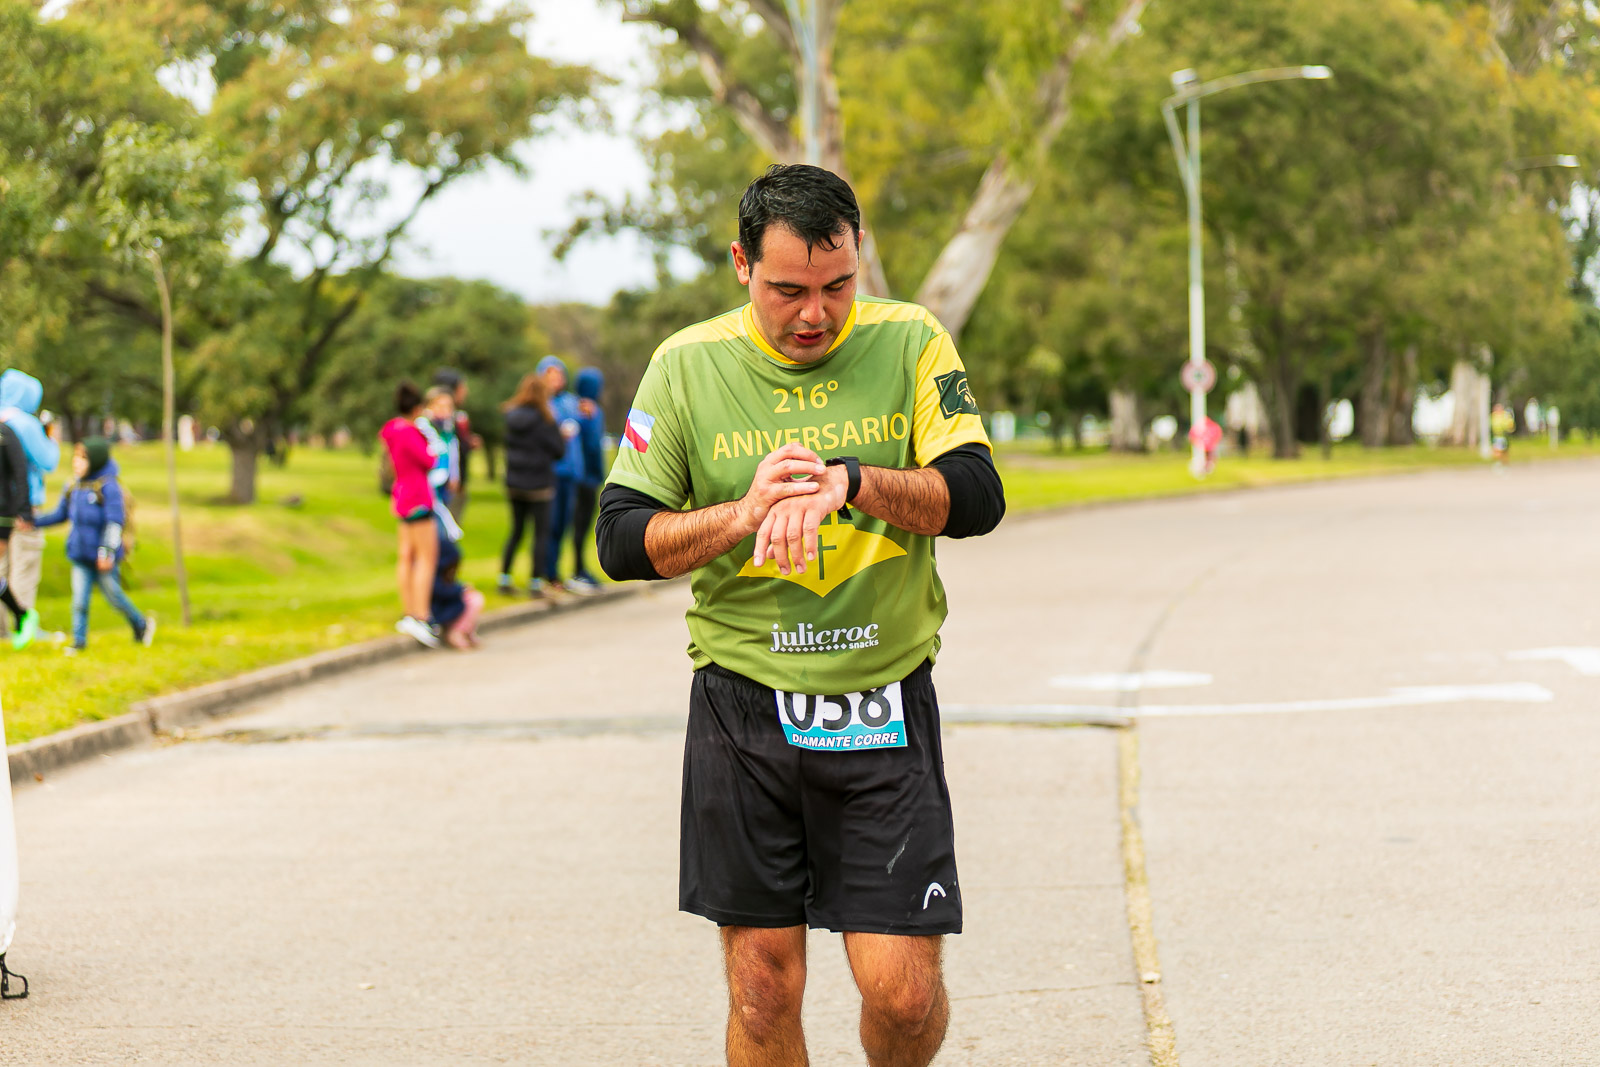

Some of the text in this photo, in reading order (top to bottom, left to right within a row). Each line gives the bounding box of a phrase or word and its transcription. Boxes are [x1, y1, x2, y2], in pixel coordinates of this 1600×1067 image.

[772, 380, 839, 414] 216°
[713, 412, 908, 461] ANIVERSARIO
[769, 622, 879, 653] julicroc
[848, 639, 879, 650] snacks
[783, 684, 892, 731] 058
[792, 731, 899, 748] DIAMANTE CORRE
